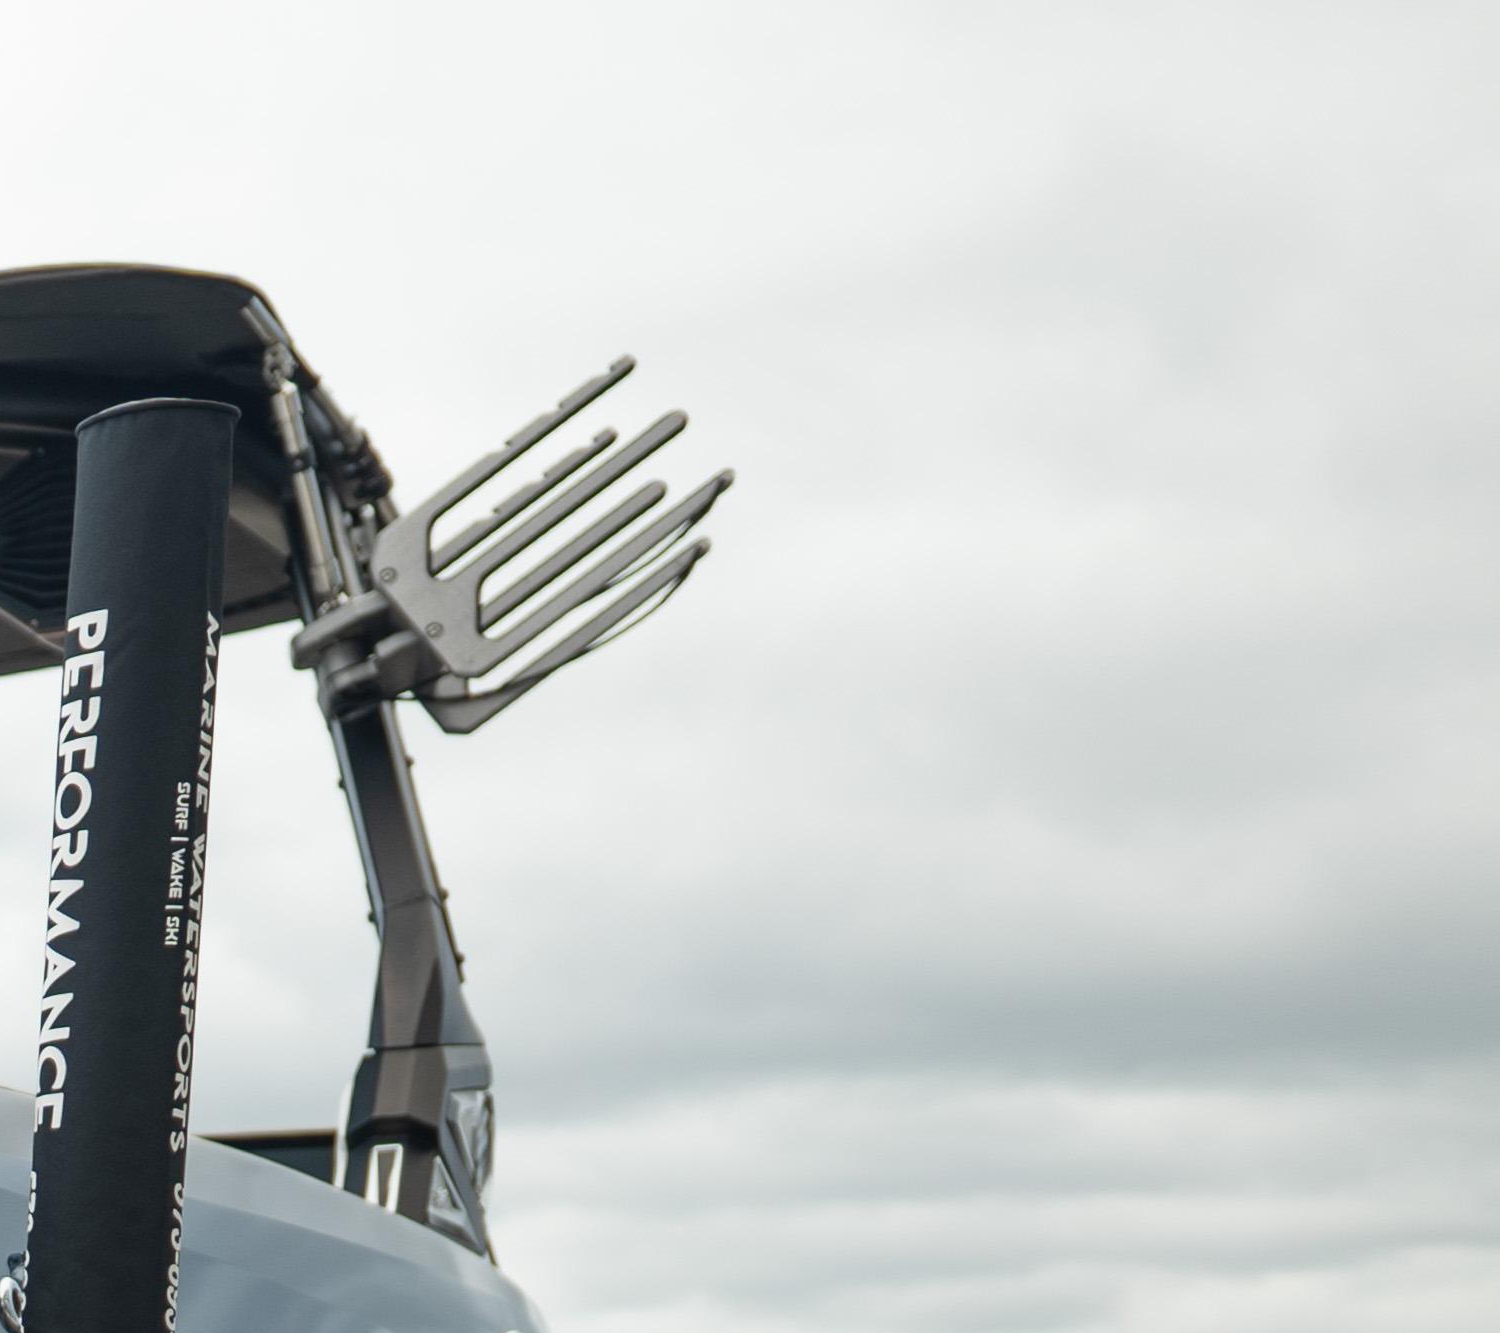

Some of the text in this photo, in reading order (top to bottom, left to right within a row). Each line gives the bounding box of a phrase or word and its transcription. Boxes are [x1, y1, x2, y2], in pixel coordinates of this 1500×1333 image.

[34, 608, 109, 1133] PERFORMANCE
[164, 781, 192, 947] SURF WAKE SKI
[169, 610, 222, 1153] MARINE WATERSPORTS
